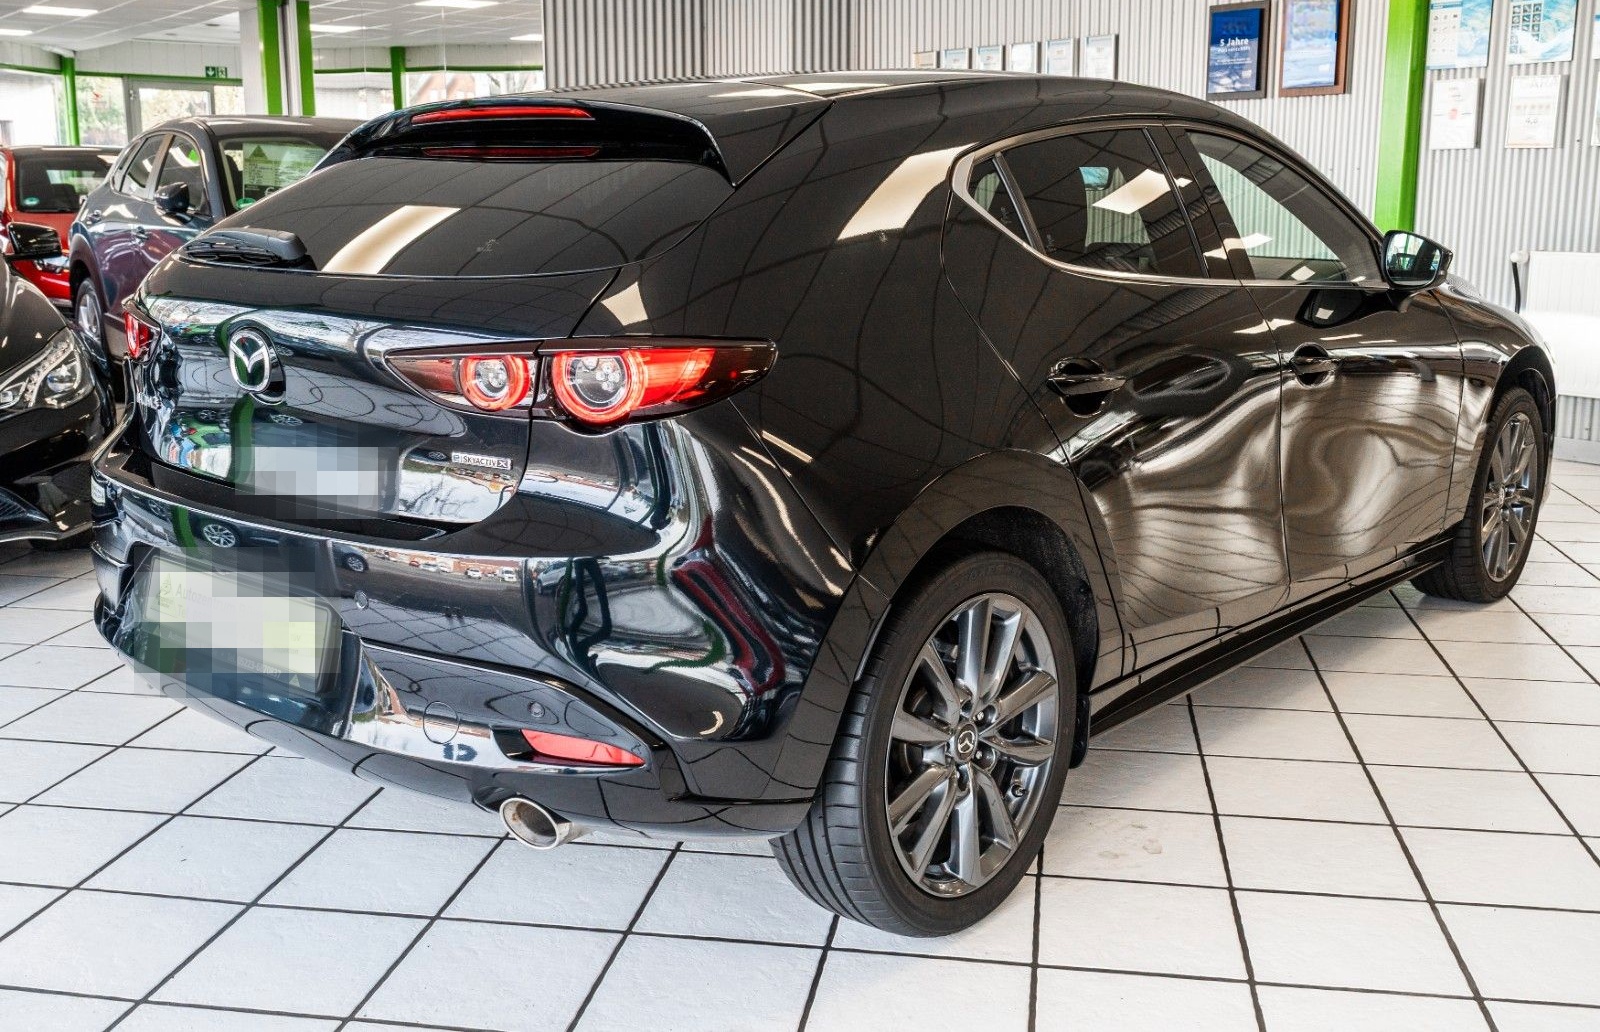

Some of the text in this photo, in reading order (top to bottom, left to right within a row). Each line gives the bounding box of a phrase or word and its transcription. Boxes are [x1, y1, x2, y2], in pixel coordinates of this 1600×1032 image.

[1220, 37, 1249, 46] 5 Jahre
[463, 455, 497, 466] SKYACTIV
